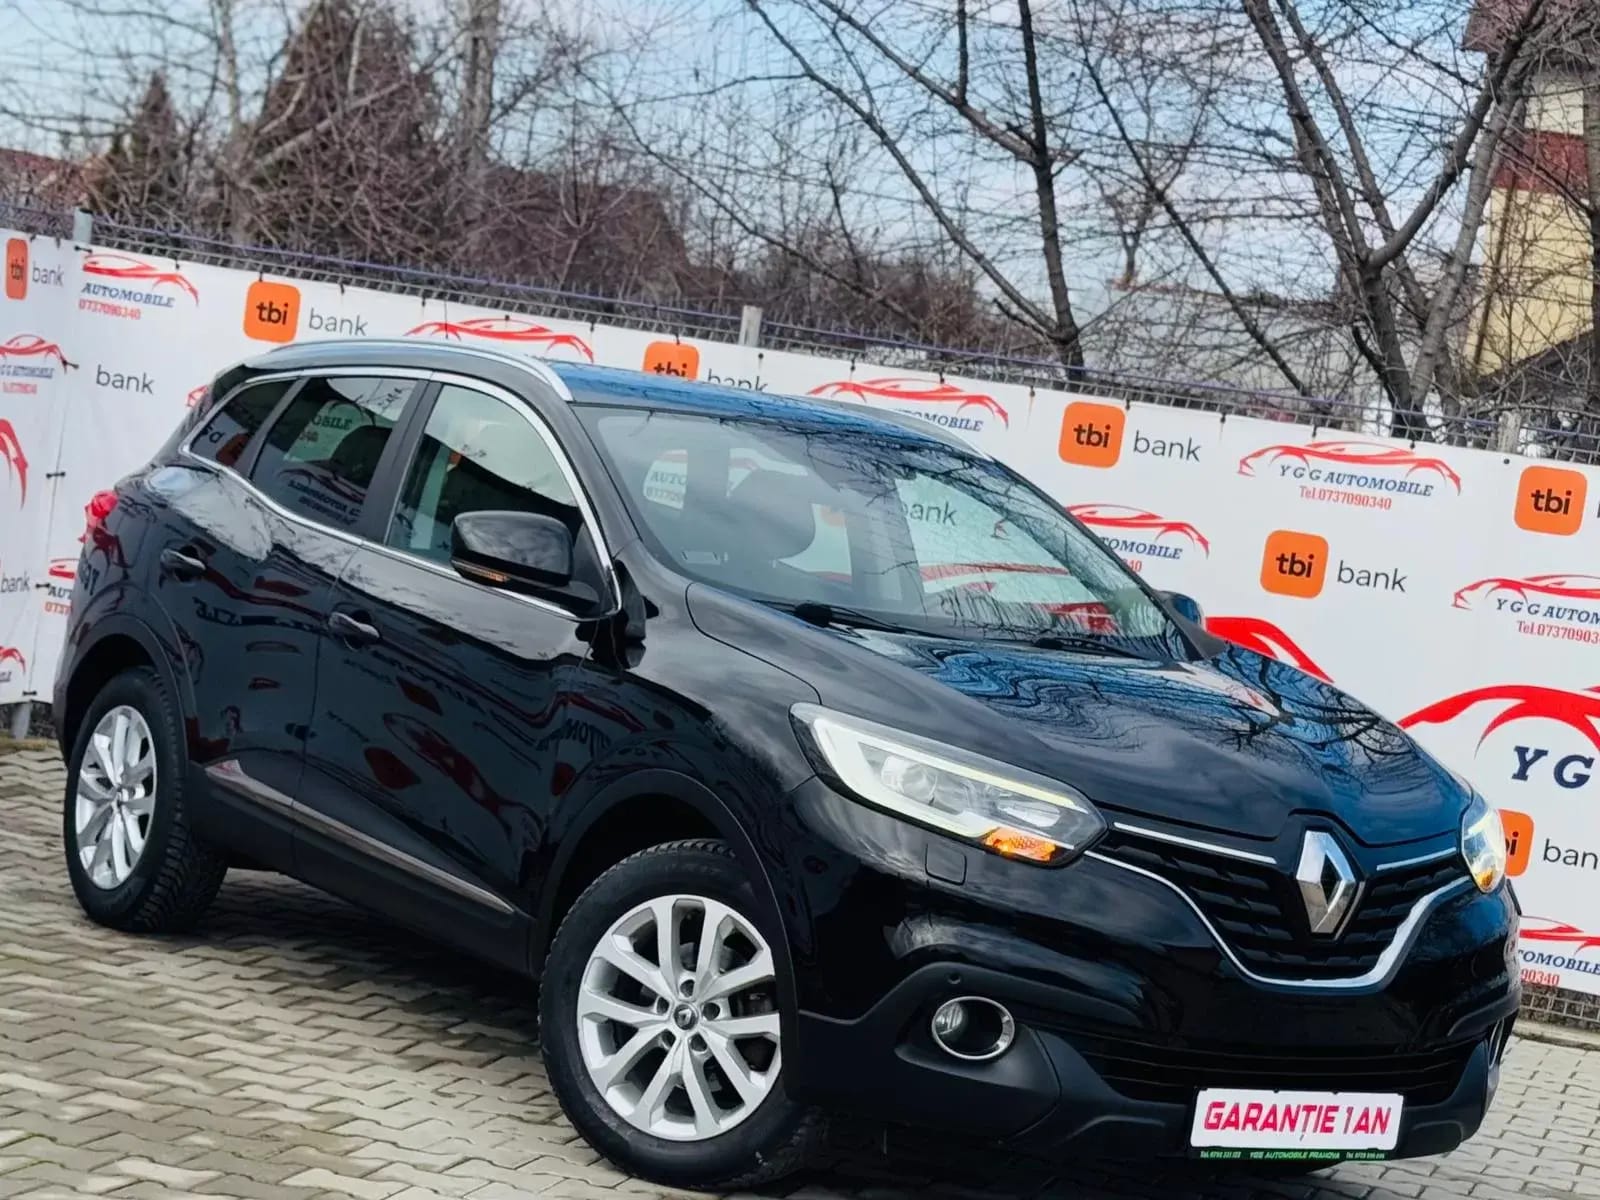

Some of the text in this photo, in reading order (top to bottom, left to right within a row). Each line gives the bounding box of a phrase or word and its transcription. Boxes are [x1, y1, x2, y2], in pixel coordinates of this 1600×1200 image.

[32, 261, 64, 287] bank
[81, 282, 176, 308] AUTOMOBILE
[256, 301, 368, 336] tbi bank
[96, 363, 155, 396] bank
[1073, 423, 1202, 463] tbi bank
[1323, 471, 1435, 497] AUTOMOBILE
[1530, 488, 1573, 515] tbi
[1275, 552, 1408, 593] tbi bank
